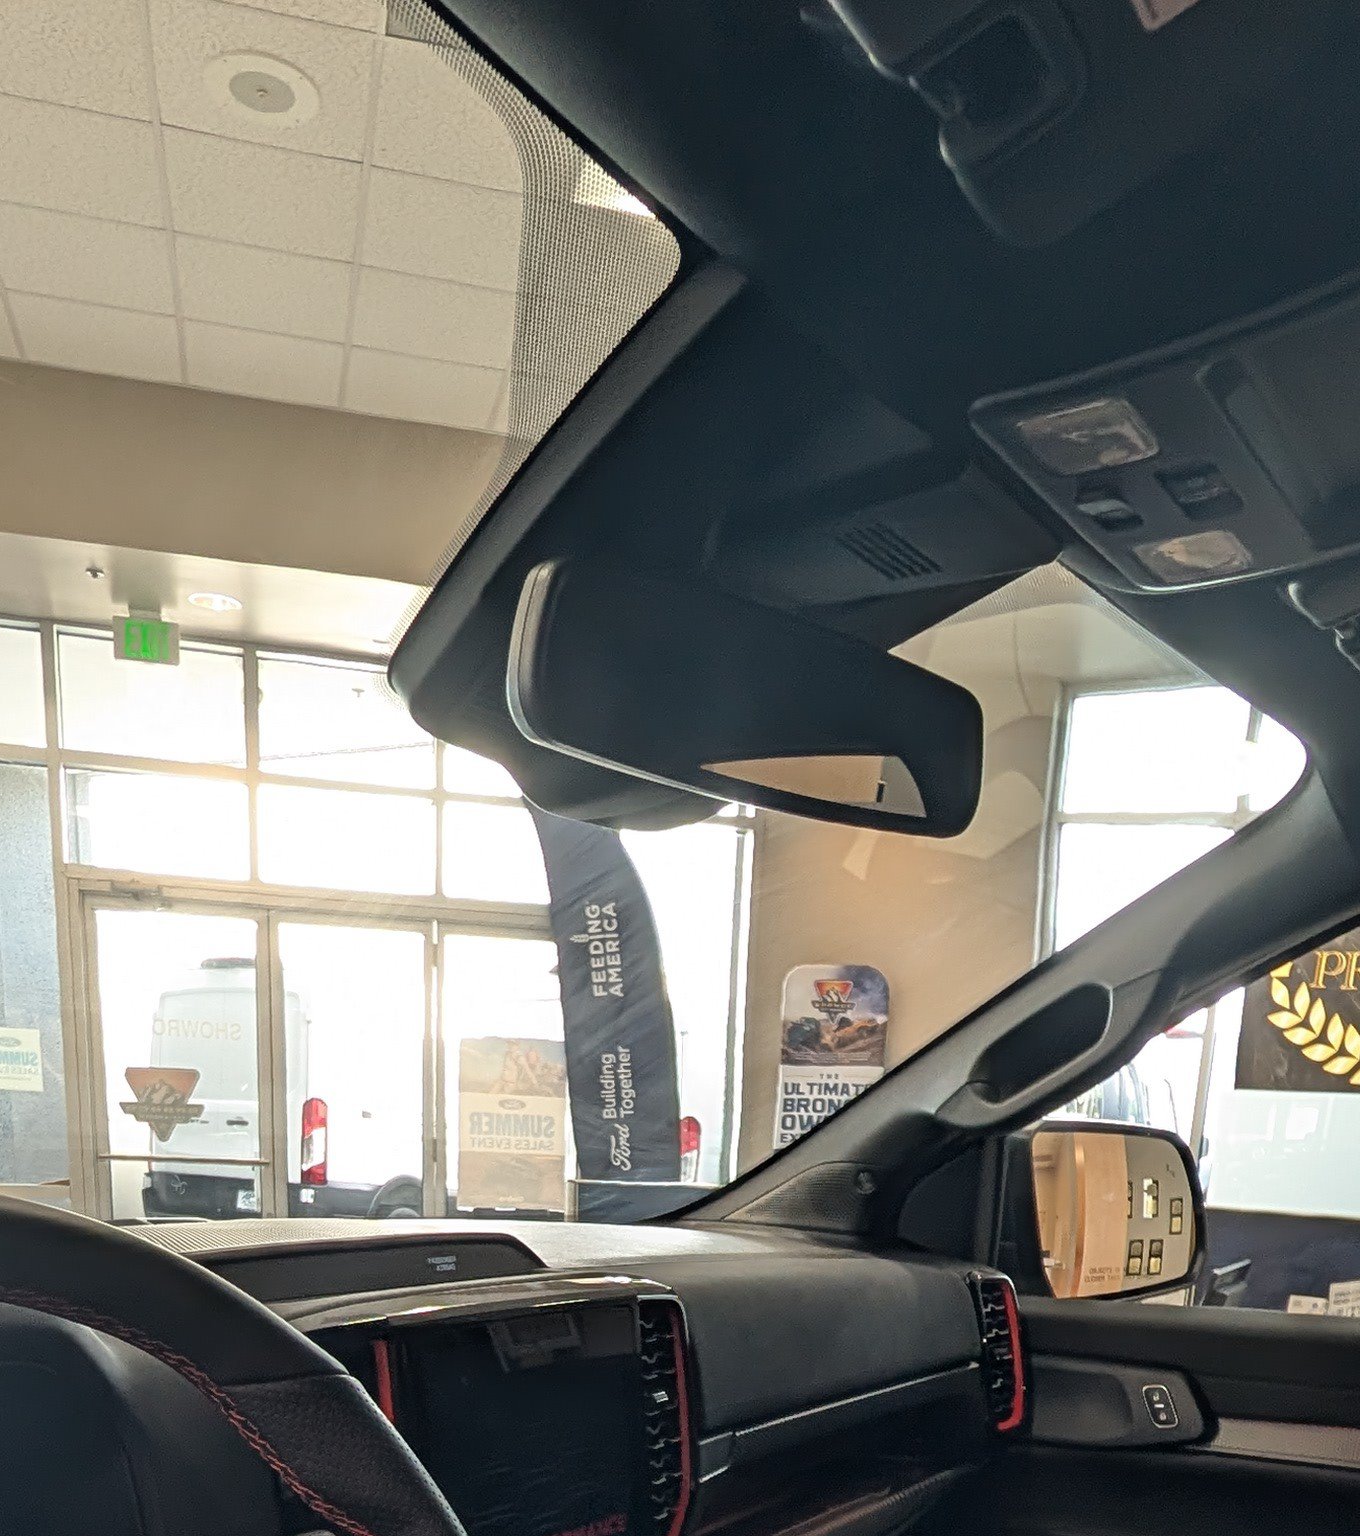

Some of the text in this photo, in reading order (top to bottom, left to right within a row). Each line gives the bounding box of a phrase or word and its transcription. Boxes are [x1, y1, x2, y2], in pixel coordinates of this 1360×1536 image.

[124, 619, 169, 660] EXIT
[584, 904, 608, 997] FEEDING
[602, 902, 624, 997] AMERICA
[602, 1053, 616, 1119] Building
[618, 1045, 635, 1119] Together
[782, 1098, 846, 1113] BRON
[610, 1124, 632, 1171] Ford
